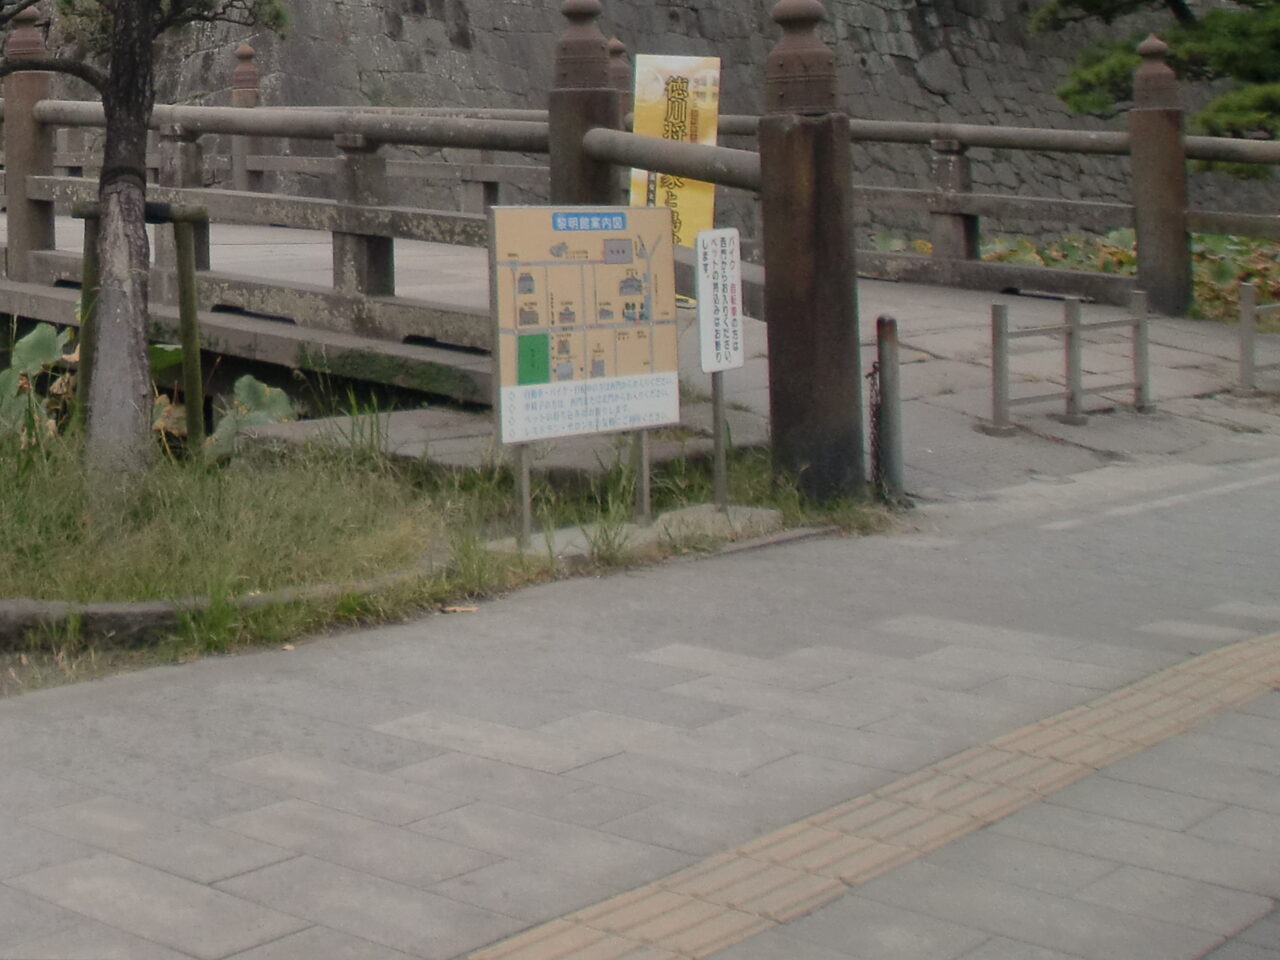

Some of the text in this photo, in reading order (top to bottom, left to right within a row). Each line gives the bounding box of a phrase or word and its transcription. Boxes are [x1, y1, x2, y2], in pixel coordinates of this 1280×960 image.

[556, 215, 624, 230] 黎明館案内図
